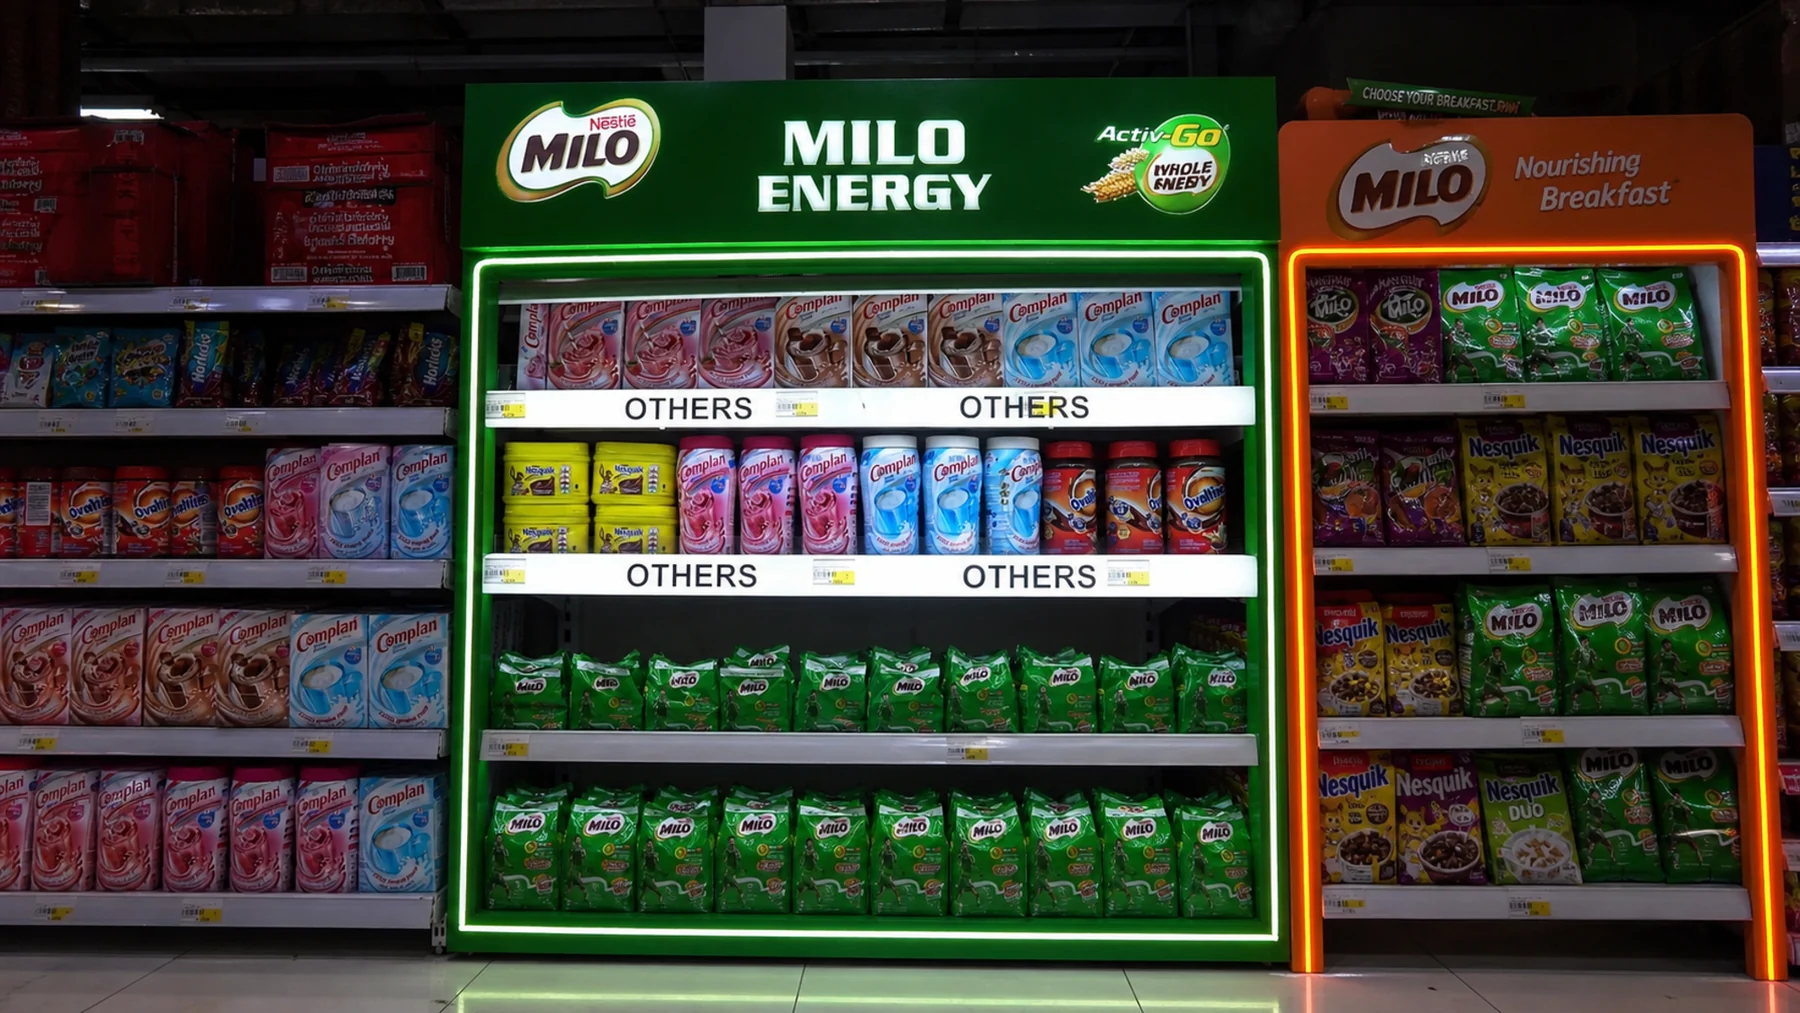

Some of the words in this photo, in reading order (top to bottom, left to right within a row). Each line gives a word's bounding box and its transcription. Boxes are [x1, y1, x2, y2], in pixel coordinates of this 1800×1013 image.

[1362, 86, 1403, 103] CHOOSE
[1406, 90, 1434, 106] YOUR
[783, 119, 966, 165] MILO
[1096, 123, 1222, 147] Activ-Go
[521, 129, 640, 173] MILO
[1514, 150, 1642, 180] Nourishing
[757, 173, 992, 212] ENERGY
[1350, 164, 1474, 214] MILO
[1539, 179, 1672, 212] Breakfast
[1009, 292, 1068, 323] Complan
[1085, 291, 1143, 322] Complan
[1161, 293, 1222, 325] Complan
[1452, 288, 1499, 306] MILO
[1622, 288, 1671, 306] MILO
[524, 304, 539, 349] Compla
[625, 397, 752, 420] OTHERS
[960, 395, 1089, 418] OTHERS
[1468, 433, 1541, 459] Nesquik
[1559, 432, 1627, 459] Nesquik
[1641, 429, 1715, 458] Nesquik
[267, 454, 317, 483] Complan
[327, 451, 380, 481] Complan
[396, 452, 448, 481] Complan
[680, 454, 726, 483] Complan
[739, 453, 784, 483] Complan
[801, 453, 847, 482] Complan
[870, 454, 917, 482] Complan
[627, 563, 757, 588] OTHERS
[963, 564, 1096, 589] OTHERS
[12, 612, 64, 644] Complan
[82, 613, 136, 645] Complan
[158, 612, 214, 645] Complan
[229, 612, 287, 645] Complan
[297, 615, 357, 653] Complan
[377, 616, 437, 653] Complan
[1385, 619, 1452, 646] Nesquik
[1491, 613, 1538, 631] MILO
[740, 683, 766, 694] MILO
[823, 676, 849, 688] MILO
[895, 682, 923, 692] MILO
[1053, 671, 1079, 684] MILO
[1586, 751, 1634, 772] MILO
[1665, 755, 1713, 774] MILO
[0, 776, 24, 796] plan
[36, 777, 86, 809] Complan
[99, 778, 151, 810] Complan
[1397, 766, 1473, 800] Nesquik
[1485, 773, 1561, 804] Nesquik
[165, 786, 215, 816] Complan
[232, 785, 281, 817] Complan
[299, 785, 346, 816] Complan
[368, 783, 425, 815] Complan
[1508, 803, 1545, 822] DUO
[510, 817, 542, 830] MILO
[587, 819, 621, 832] MILO
[659, 823, 691, 835] MILO
[741, 818, 774, 832] MILO
[818, 823, 848, 836] MILO
[973, 823, 1003, 837] MILO
[1049, 822, 1078, 836] MILO
[1125, 822, 1154, 836] MILO
[1202, 826, 1231, 839] MILO
